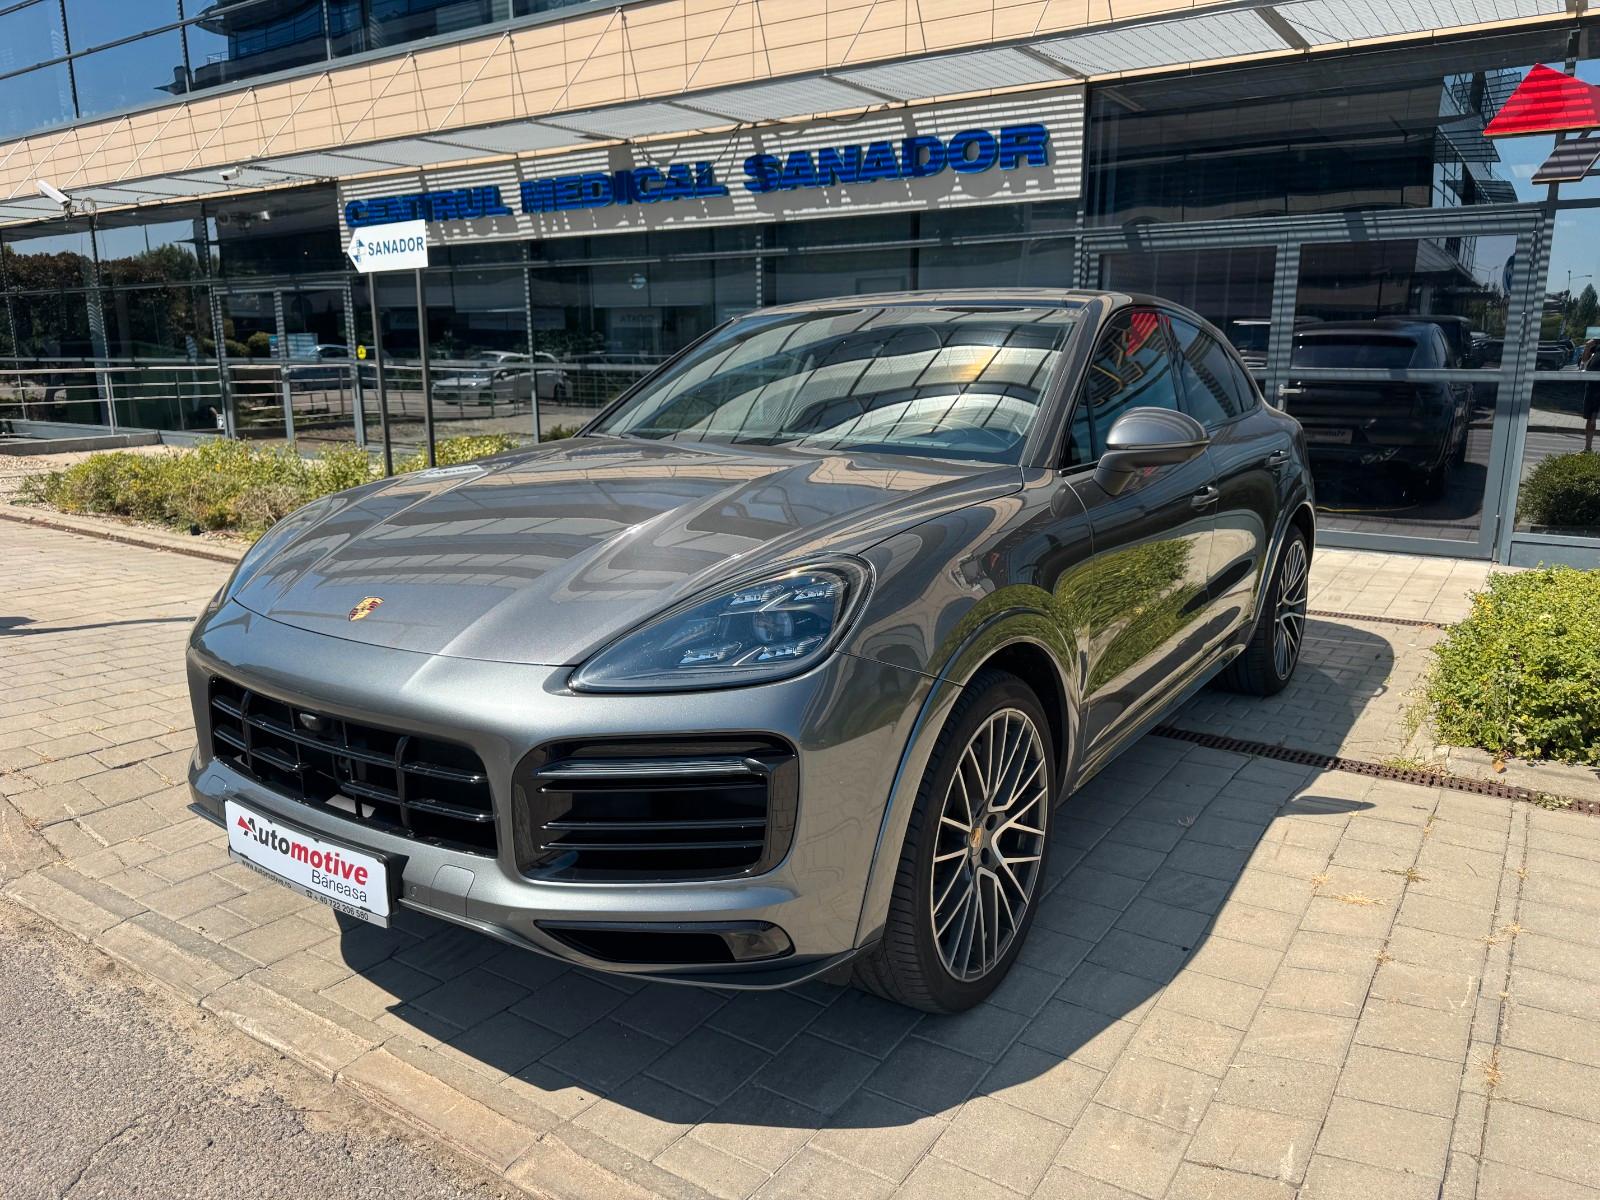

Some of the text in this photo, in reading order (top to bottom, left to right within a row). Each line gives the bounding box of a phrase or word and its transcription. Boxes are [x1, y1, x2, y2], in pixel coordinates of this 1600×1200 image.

[345, 123, 1050, 228] CENTRUL MEDICAL SANADOR
[368, 236, 424, 256] SANADOR
[238, 816, 368, 885] Automotive
[312, 869, 367, 903] Băneasa
